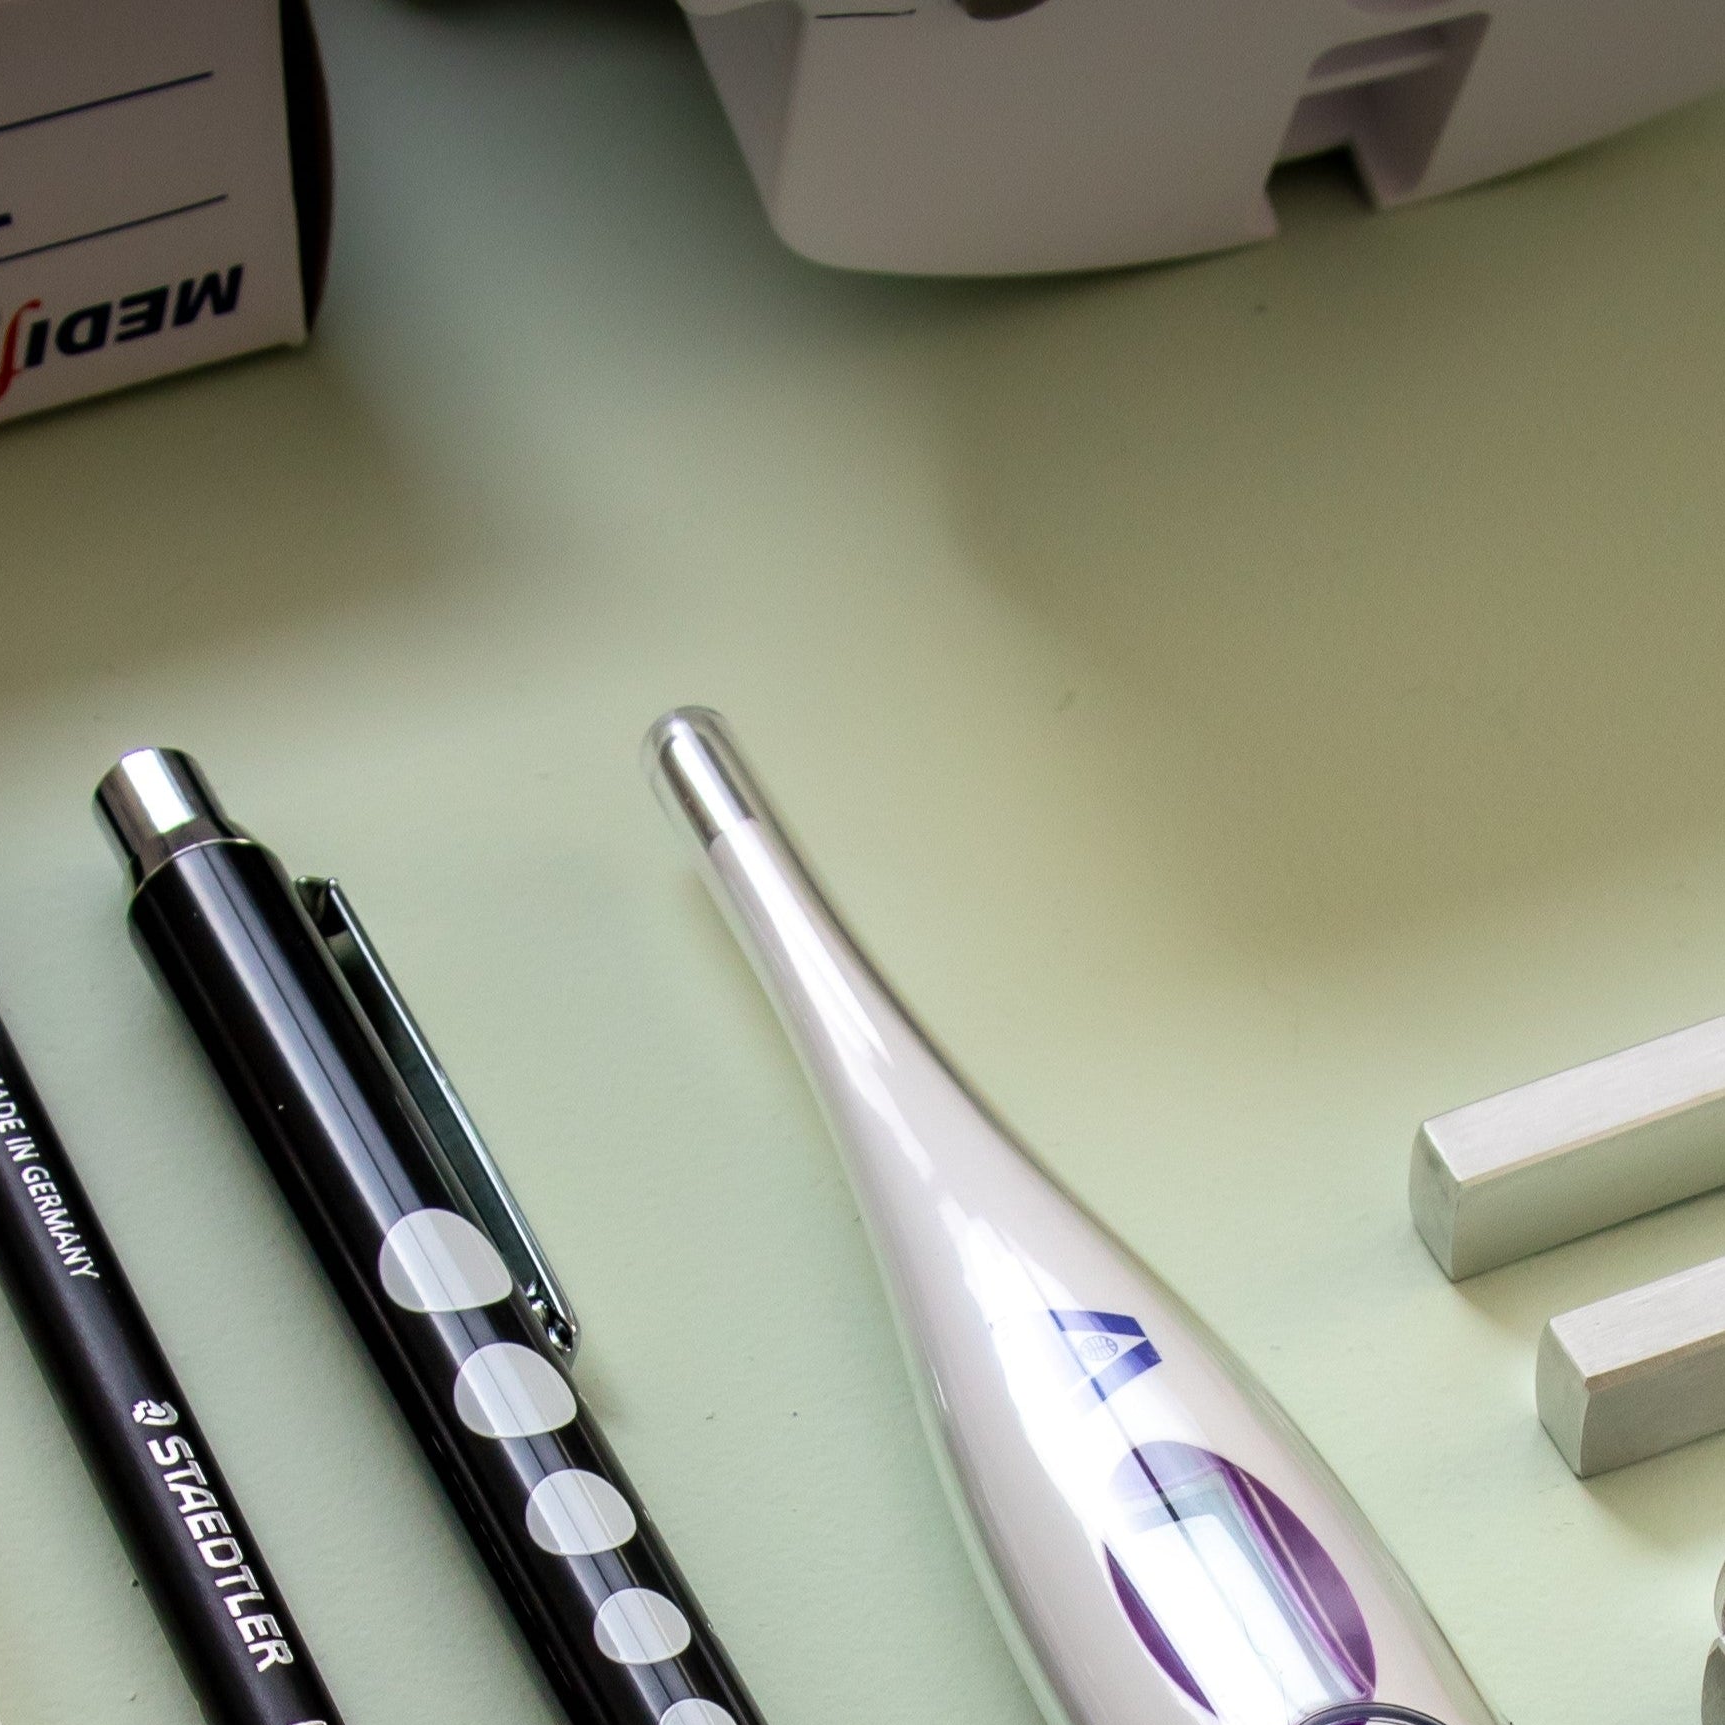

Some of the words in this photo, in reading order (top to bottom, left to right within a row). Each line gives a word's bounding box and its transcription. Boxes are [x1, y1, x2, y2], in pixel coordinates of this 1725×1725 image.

[5, 1134, 40, 1163] IN
[21, 1165, 100, 1281] GERMANY
[147, 1434, 294, 1673] STAEDTLER
